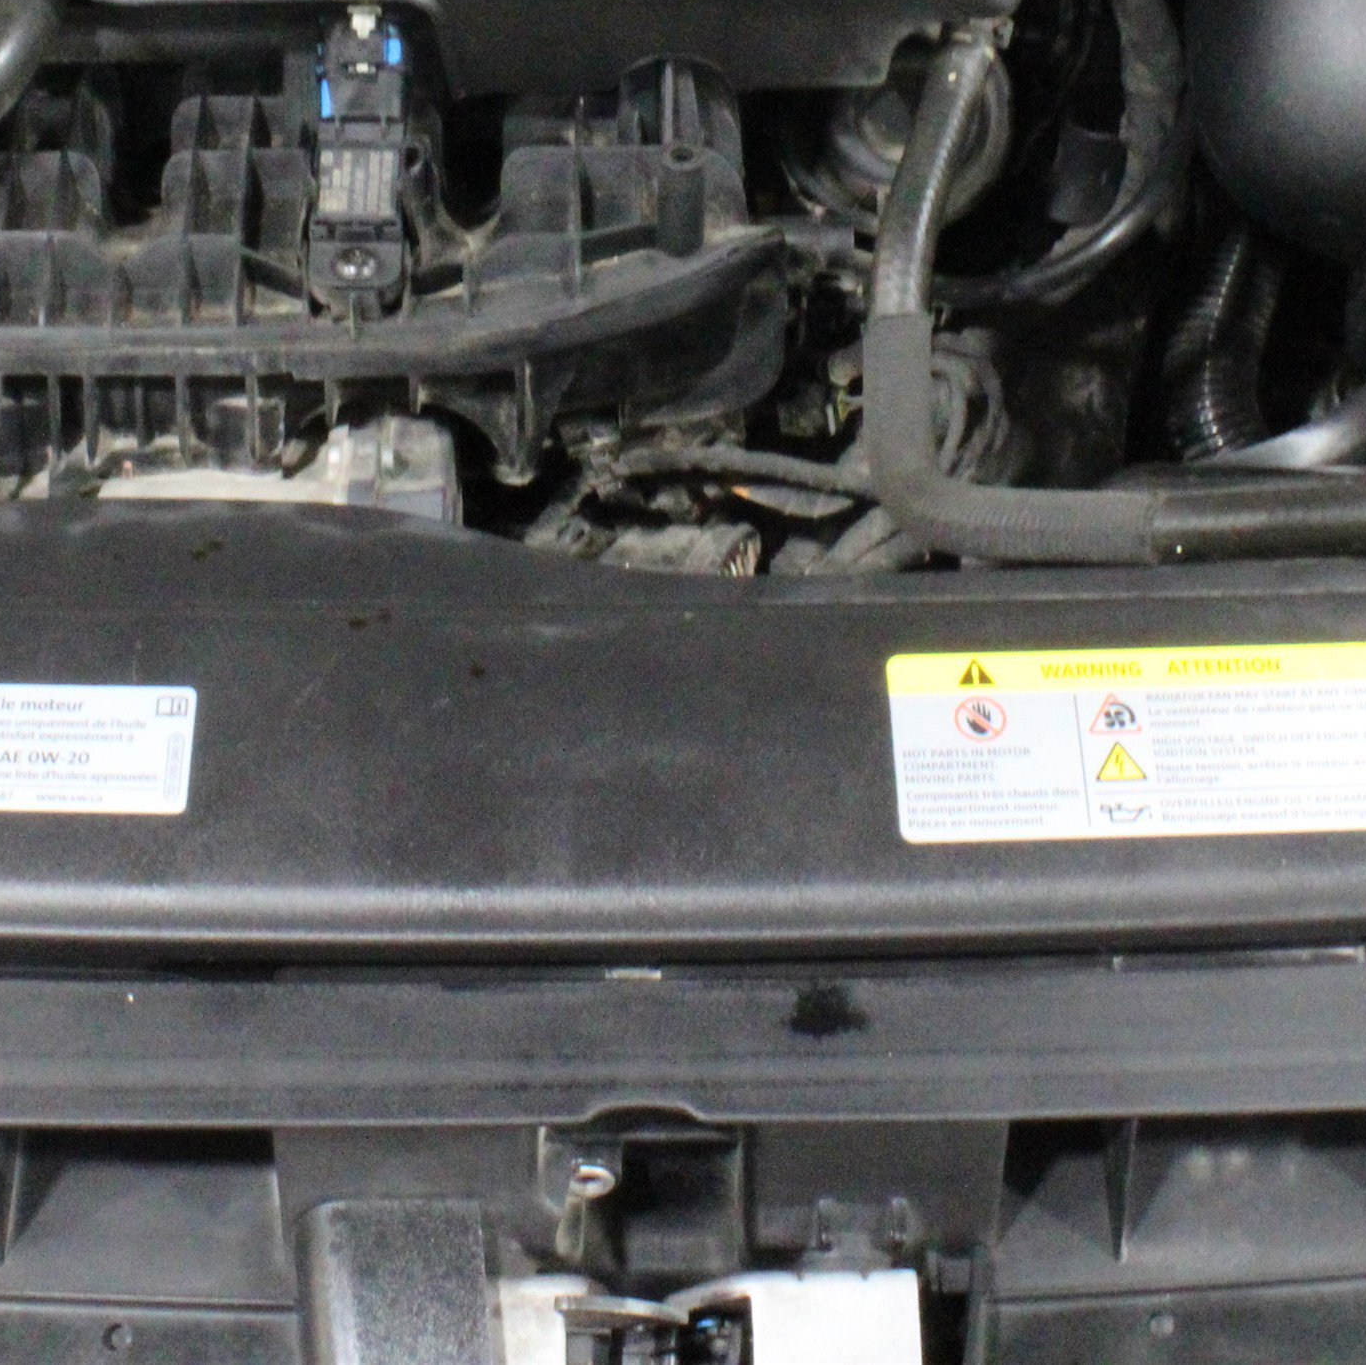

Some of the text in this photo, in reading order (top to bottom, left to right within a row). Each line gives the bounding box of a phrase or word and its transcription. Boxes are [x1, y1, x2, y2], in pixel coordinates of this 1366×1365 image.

[1040, 657, 1282, 679] WARNING ATTENTION
[21, 698, 85, 712] moteur
[27, 750, 90, 765] 0W-20
